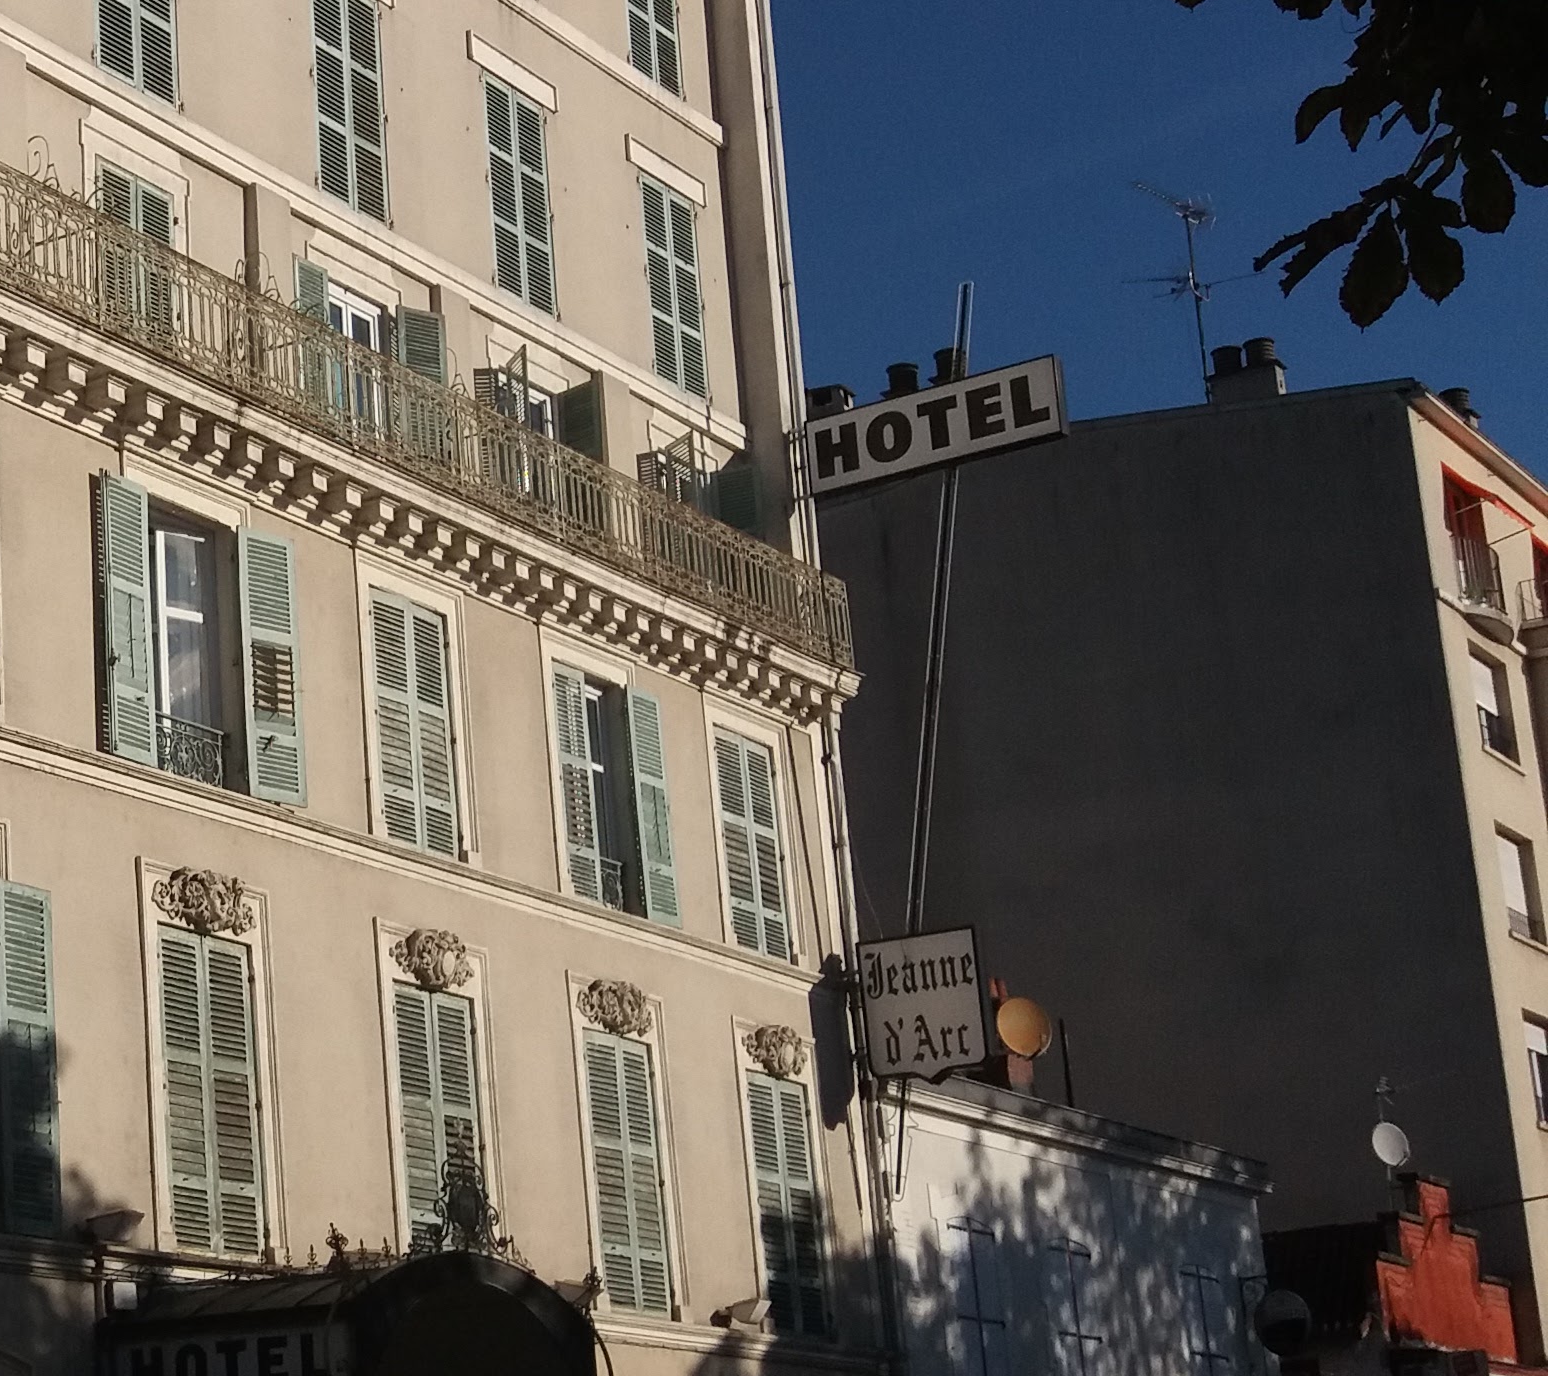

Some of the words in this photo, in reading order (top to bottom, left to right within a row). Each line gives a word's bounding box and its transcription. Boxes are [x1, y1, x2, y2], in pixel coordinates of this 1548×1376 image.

[814, 375, 1050, 479] HOTEL
[865, 952, 974, 999] Jeanne
[884, 1014, 970, 1066] d'Arc
